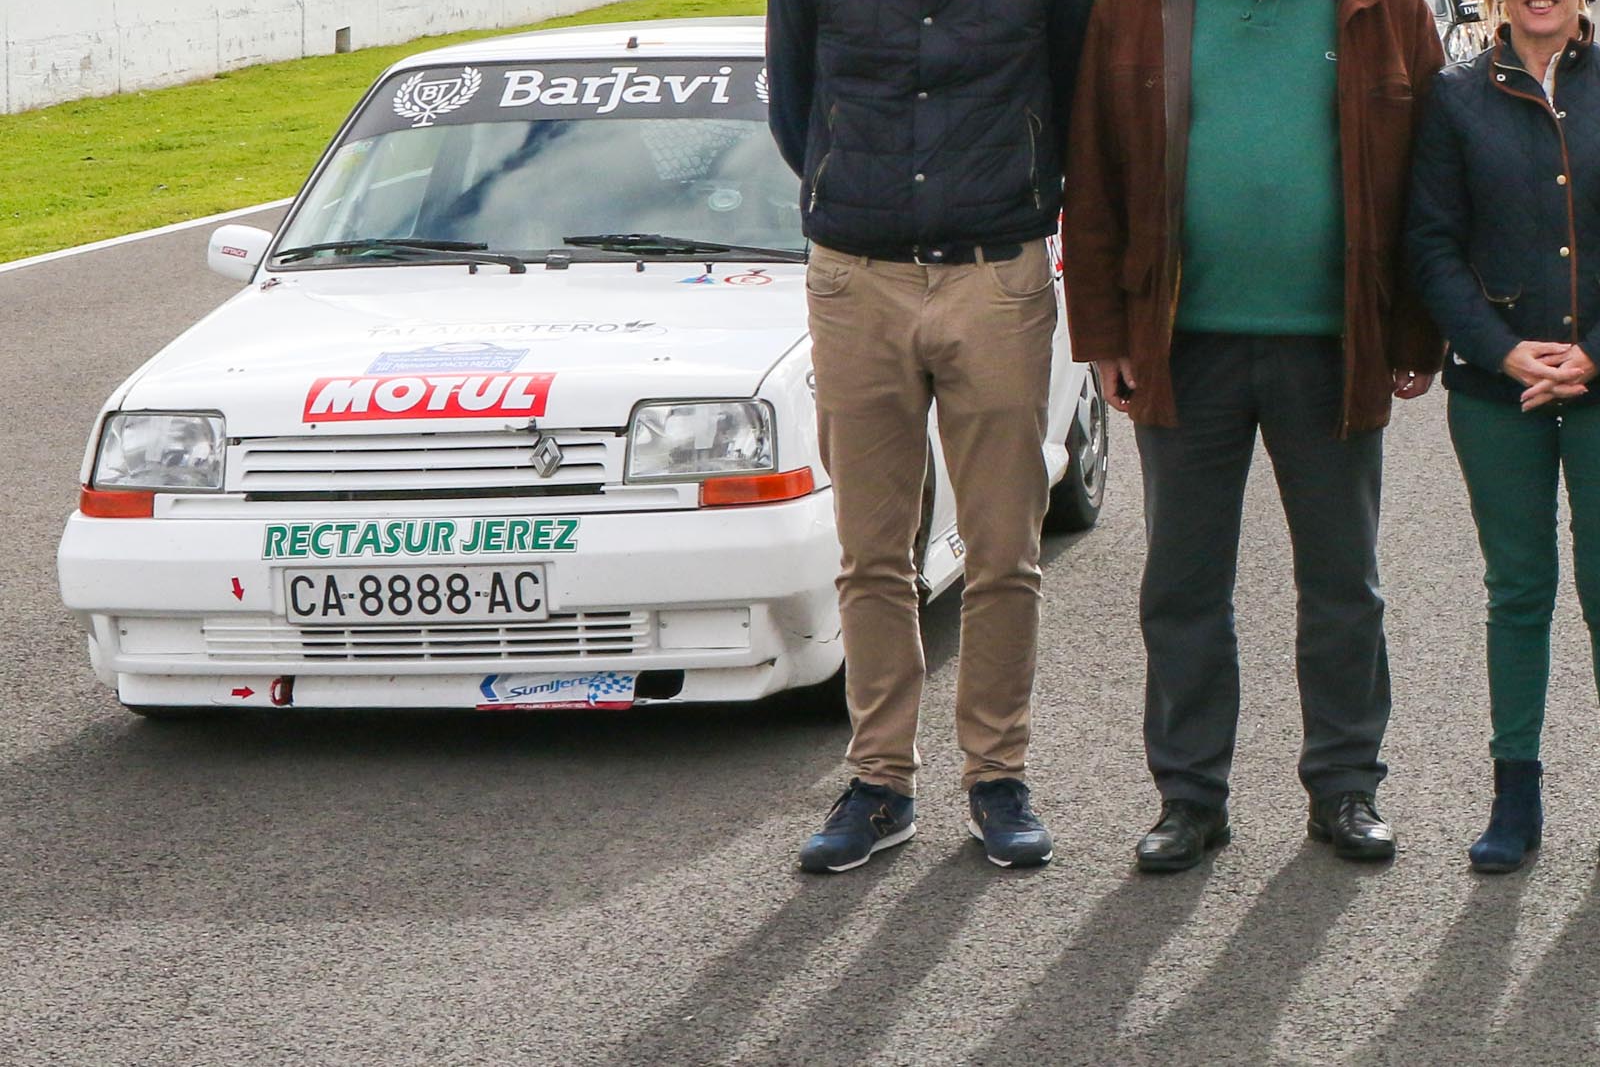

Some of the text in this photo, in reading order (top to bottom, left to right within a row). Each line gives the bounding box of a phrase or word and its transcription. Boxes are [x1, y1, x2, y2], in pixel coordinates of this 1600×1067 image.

[499, 66, 733, 114] BarJavi
[309, 376, 541, 415] MOTUL
[263, 518, 581, 558] RECTASUR JEREZ
